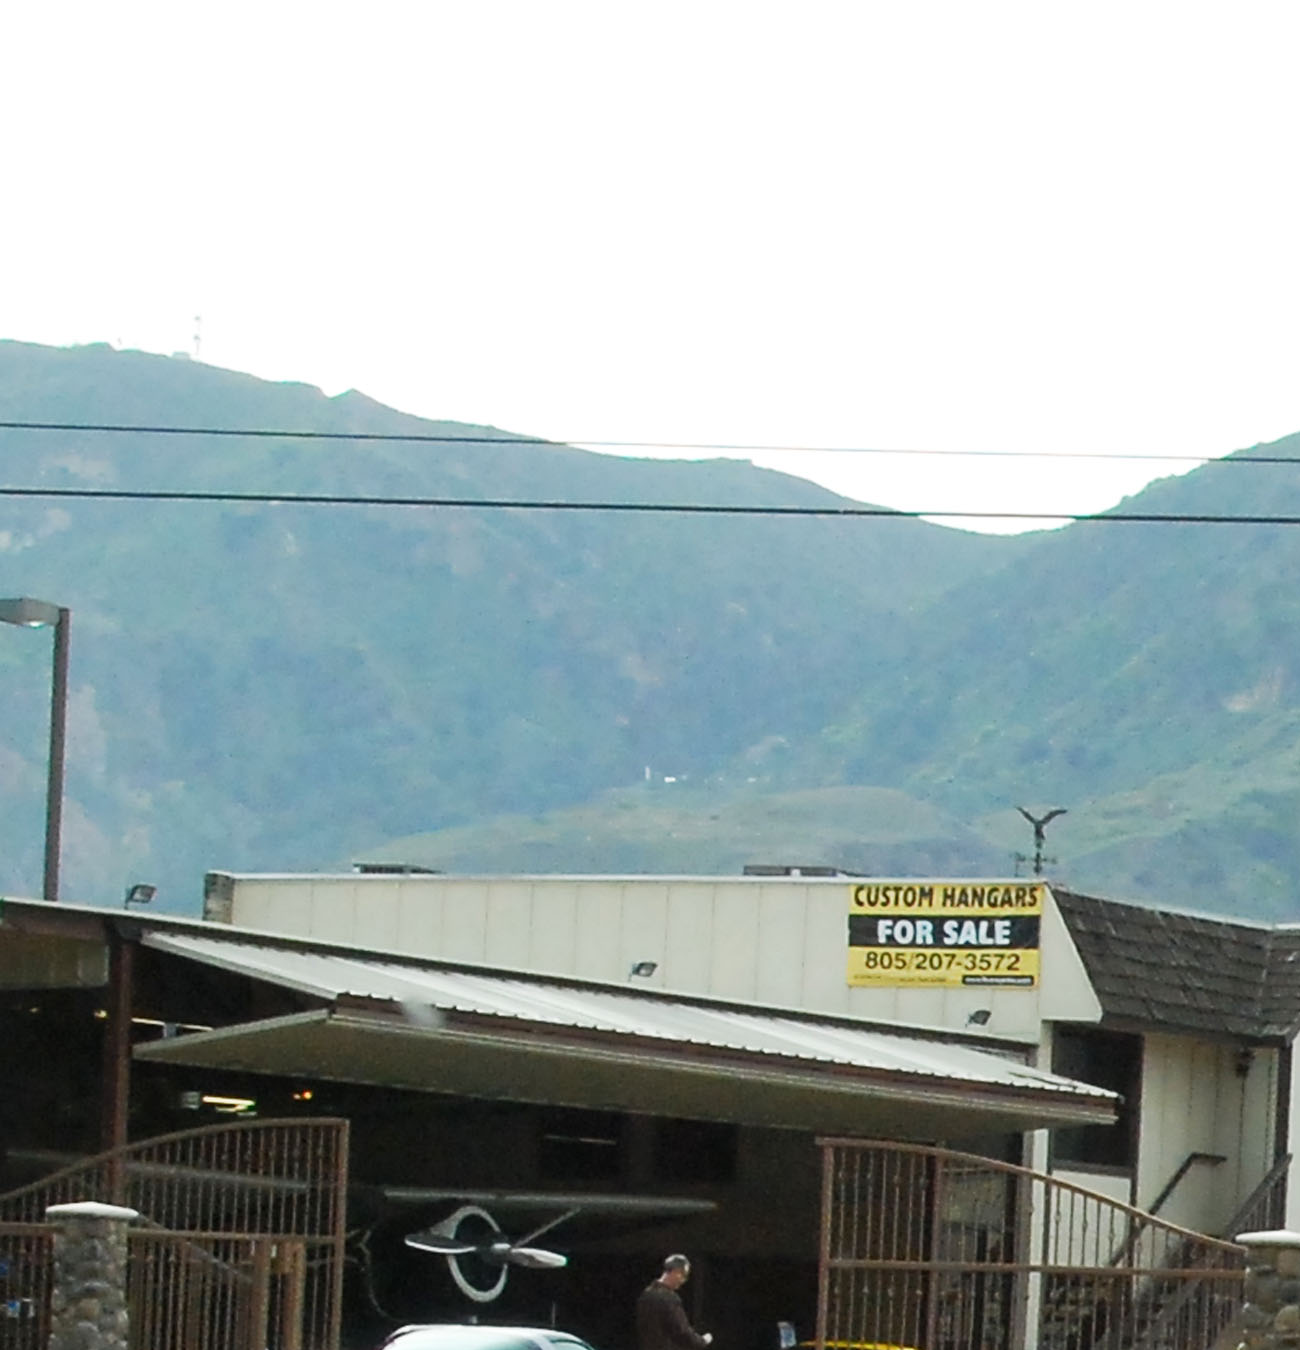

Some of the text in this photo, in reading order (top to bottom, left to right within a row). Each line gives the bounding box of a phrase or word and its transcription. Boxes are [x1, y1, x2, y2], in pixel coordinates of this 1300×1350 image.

[854, 886, 1038, 909] CUSTOM HANGARS
[877, 919, 1011, 946] FOR SALE
